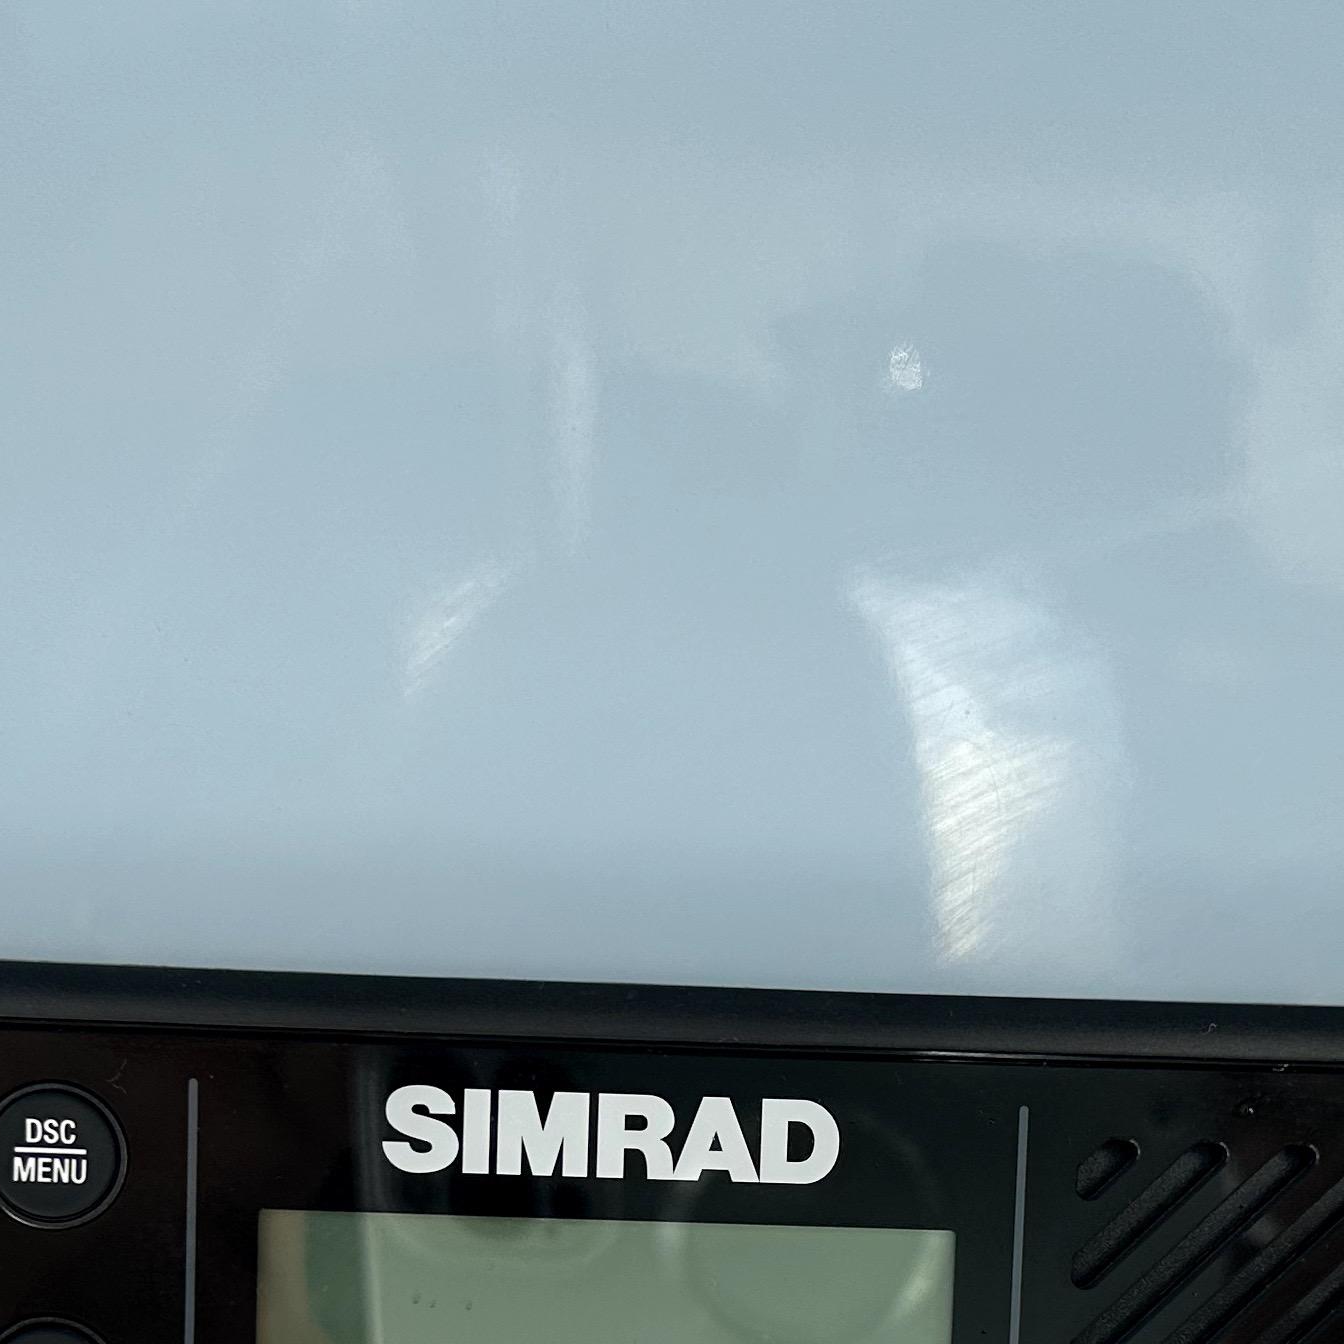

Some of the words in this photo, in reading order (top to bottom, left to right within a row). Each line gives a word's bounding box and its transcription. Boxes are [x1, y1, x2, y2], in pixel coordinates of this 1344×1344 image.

[24, 1118, 77, 1145] DSC
[381, 1084, 840, 1185] SIMRAD
[12, 1156, 87, 1185] MENU
